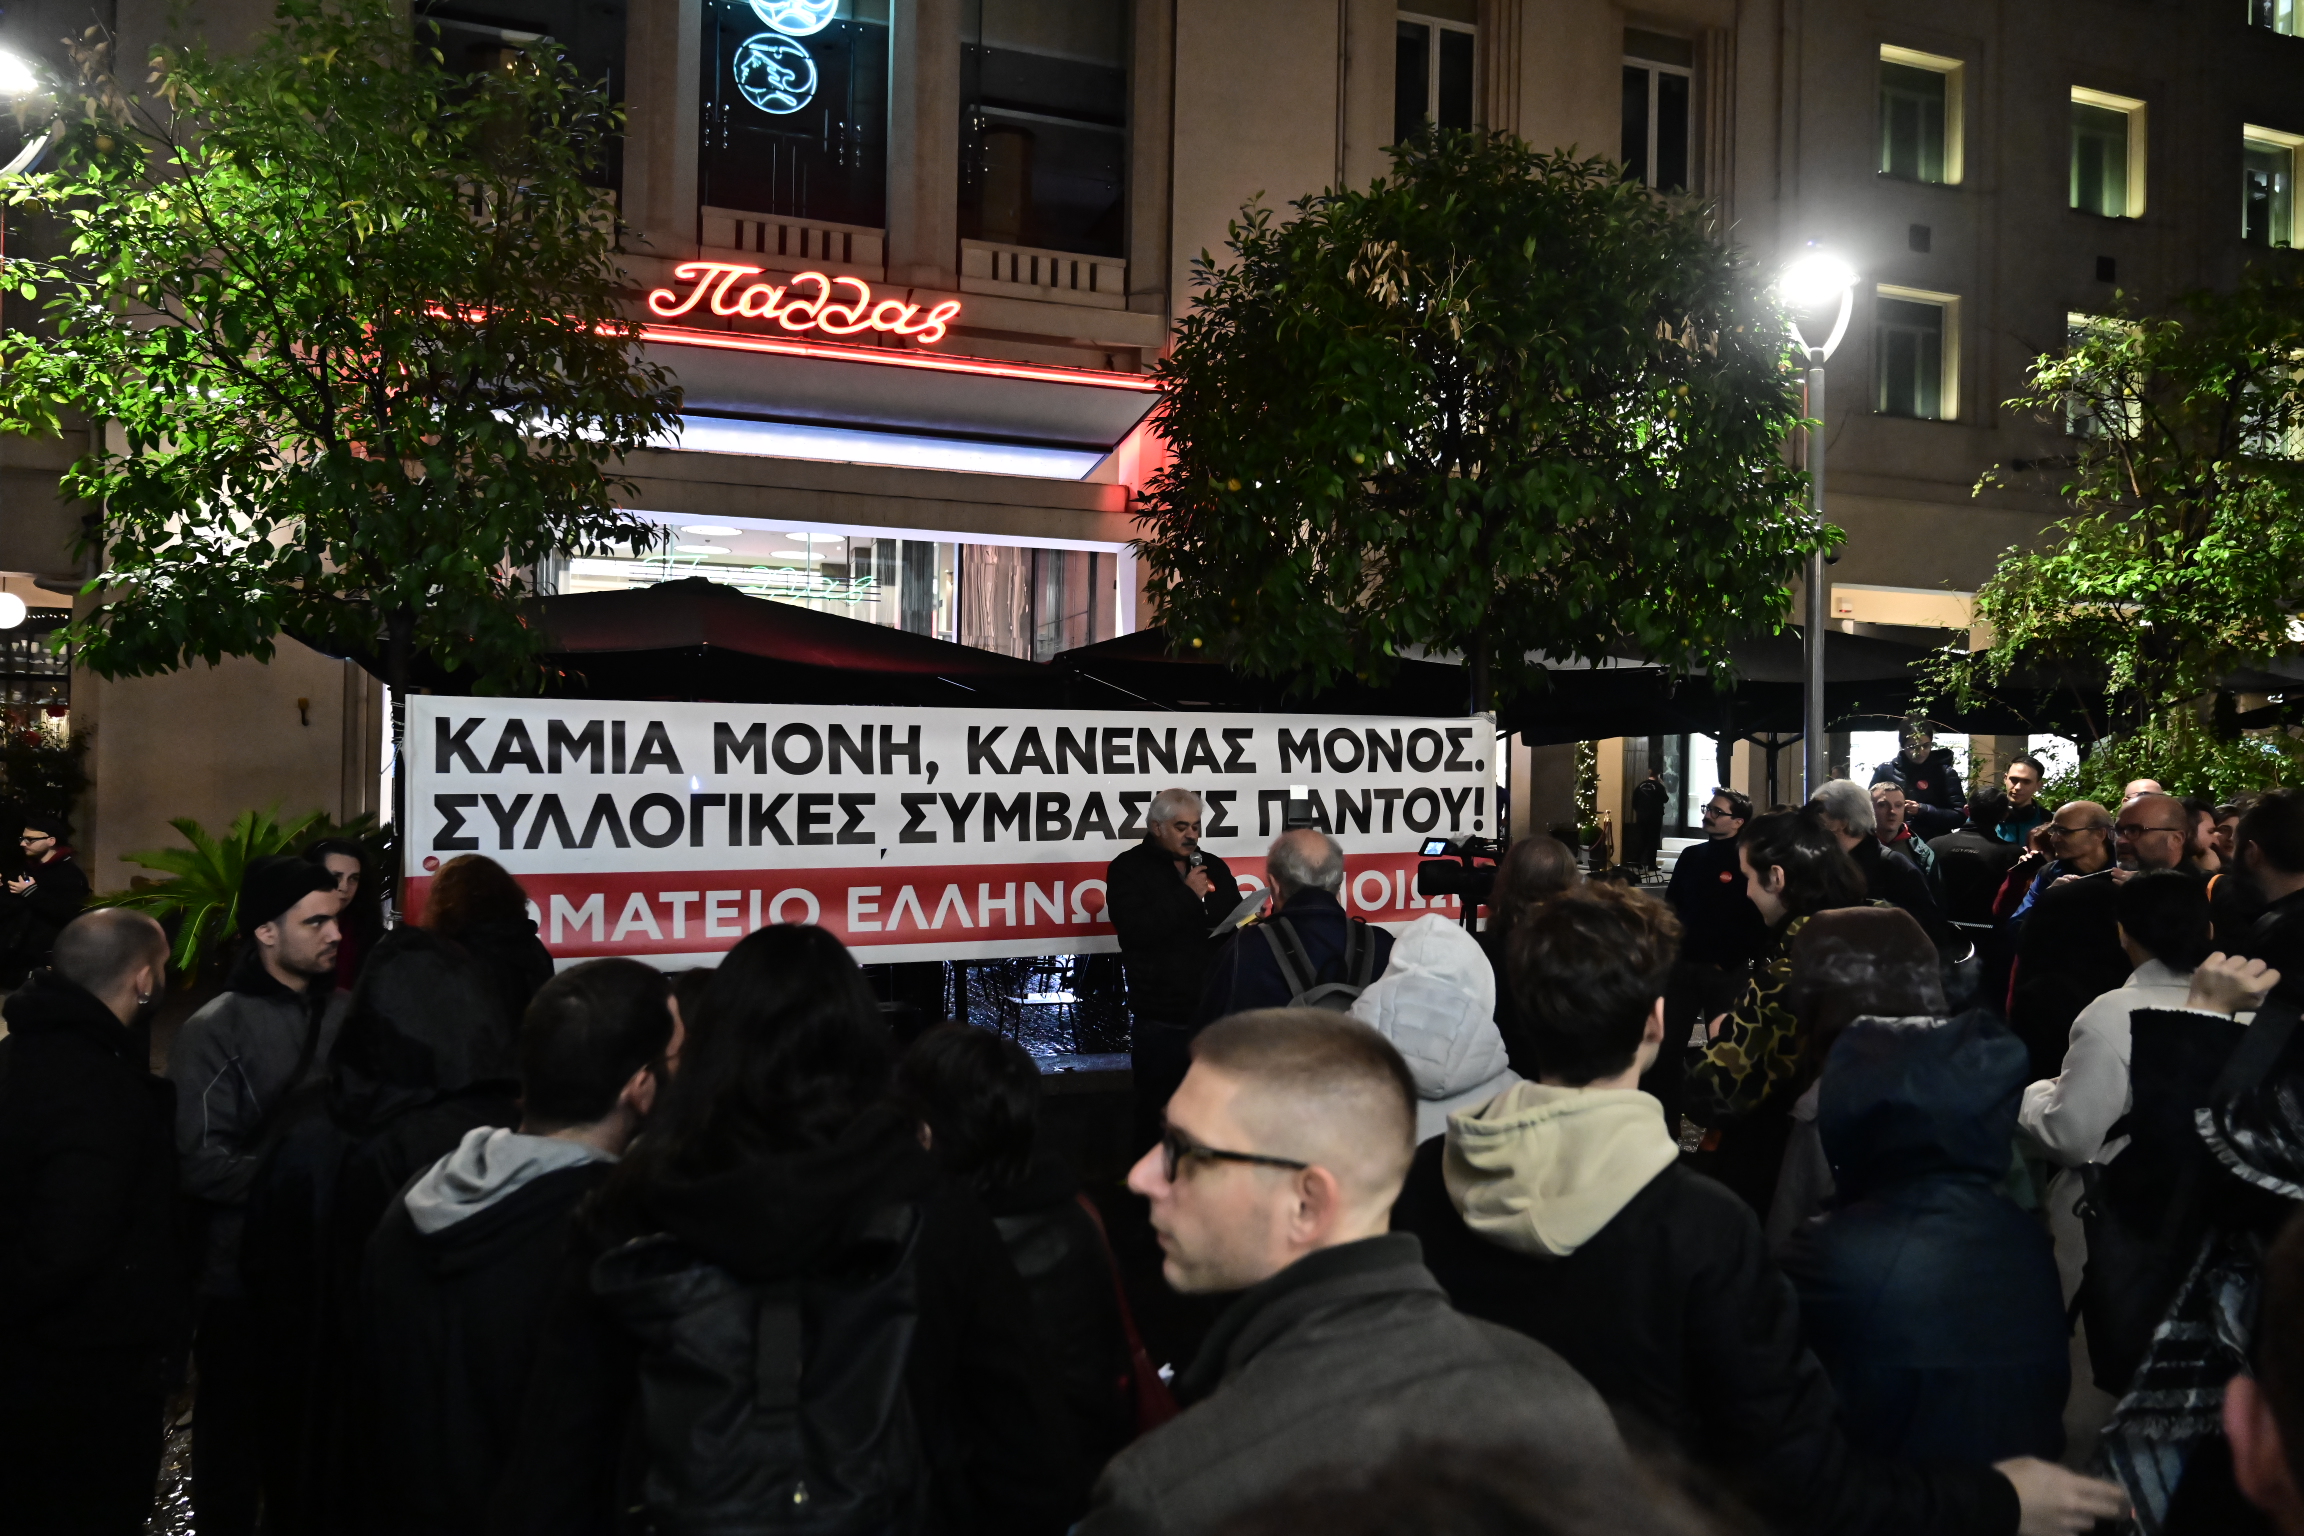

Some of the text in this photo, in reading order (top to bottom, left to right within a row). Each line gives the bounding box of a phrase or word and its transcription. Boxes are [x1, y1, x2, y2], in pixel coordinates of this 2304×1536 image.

[435, 716, 1485, 785] ΚΑΜΙΑ ΜΟΝΗ, ΚΑΝΕΝΑΣ ΜΟΝΟΣ.
[432, 792, 876, 851] ΣΥΛΛΟΓΙΚΕΣ
[898, 789, 1239, 844] ΣΥΜΒΑΣΣ
[847, 878, 1110, 933] ΕΛΛΗΝΩ
